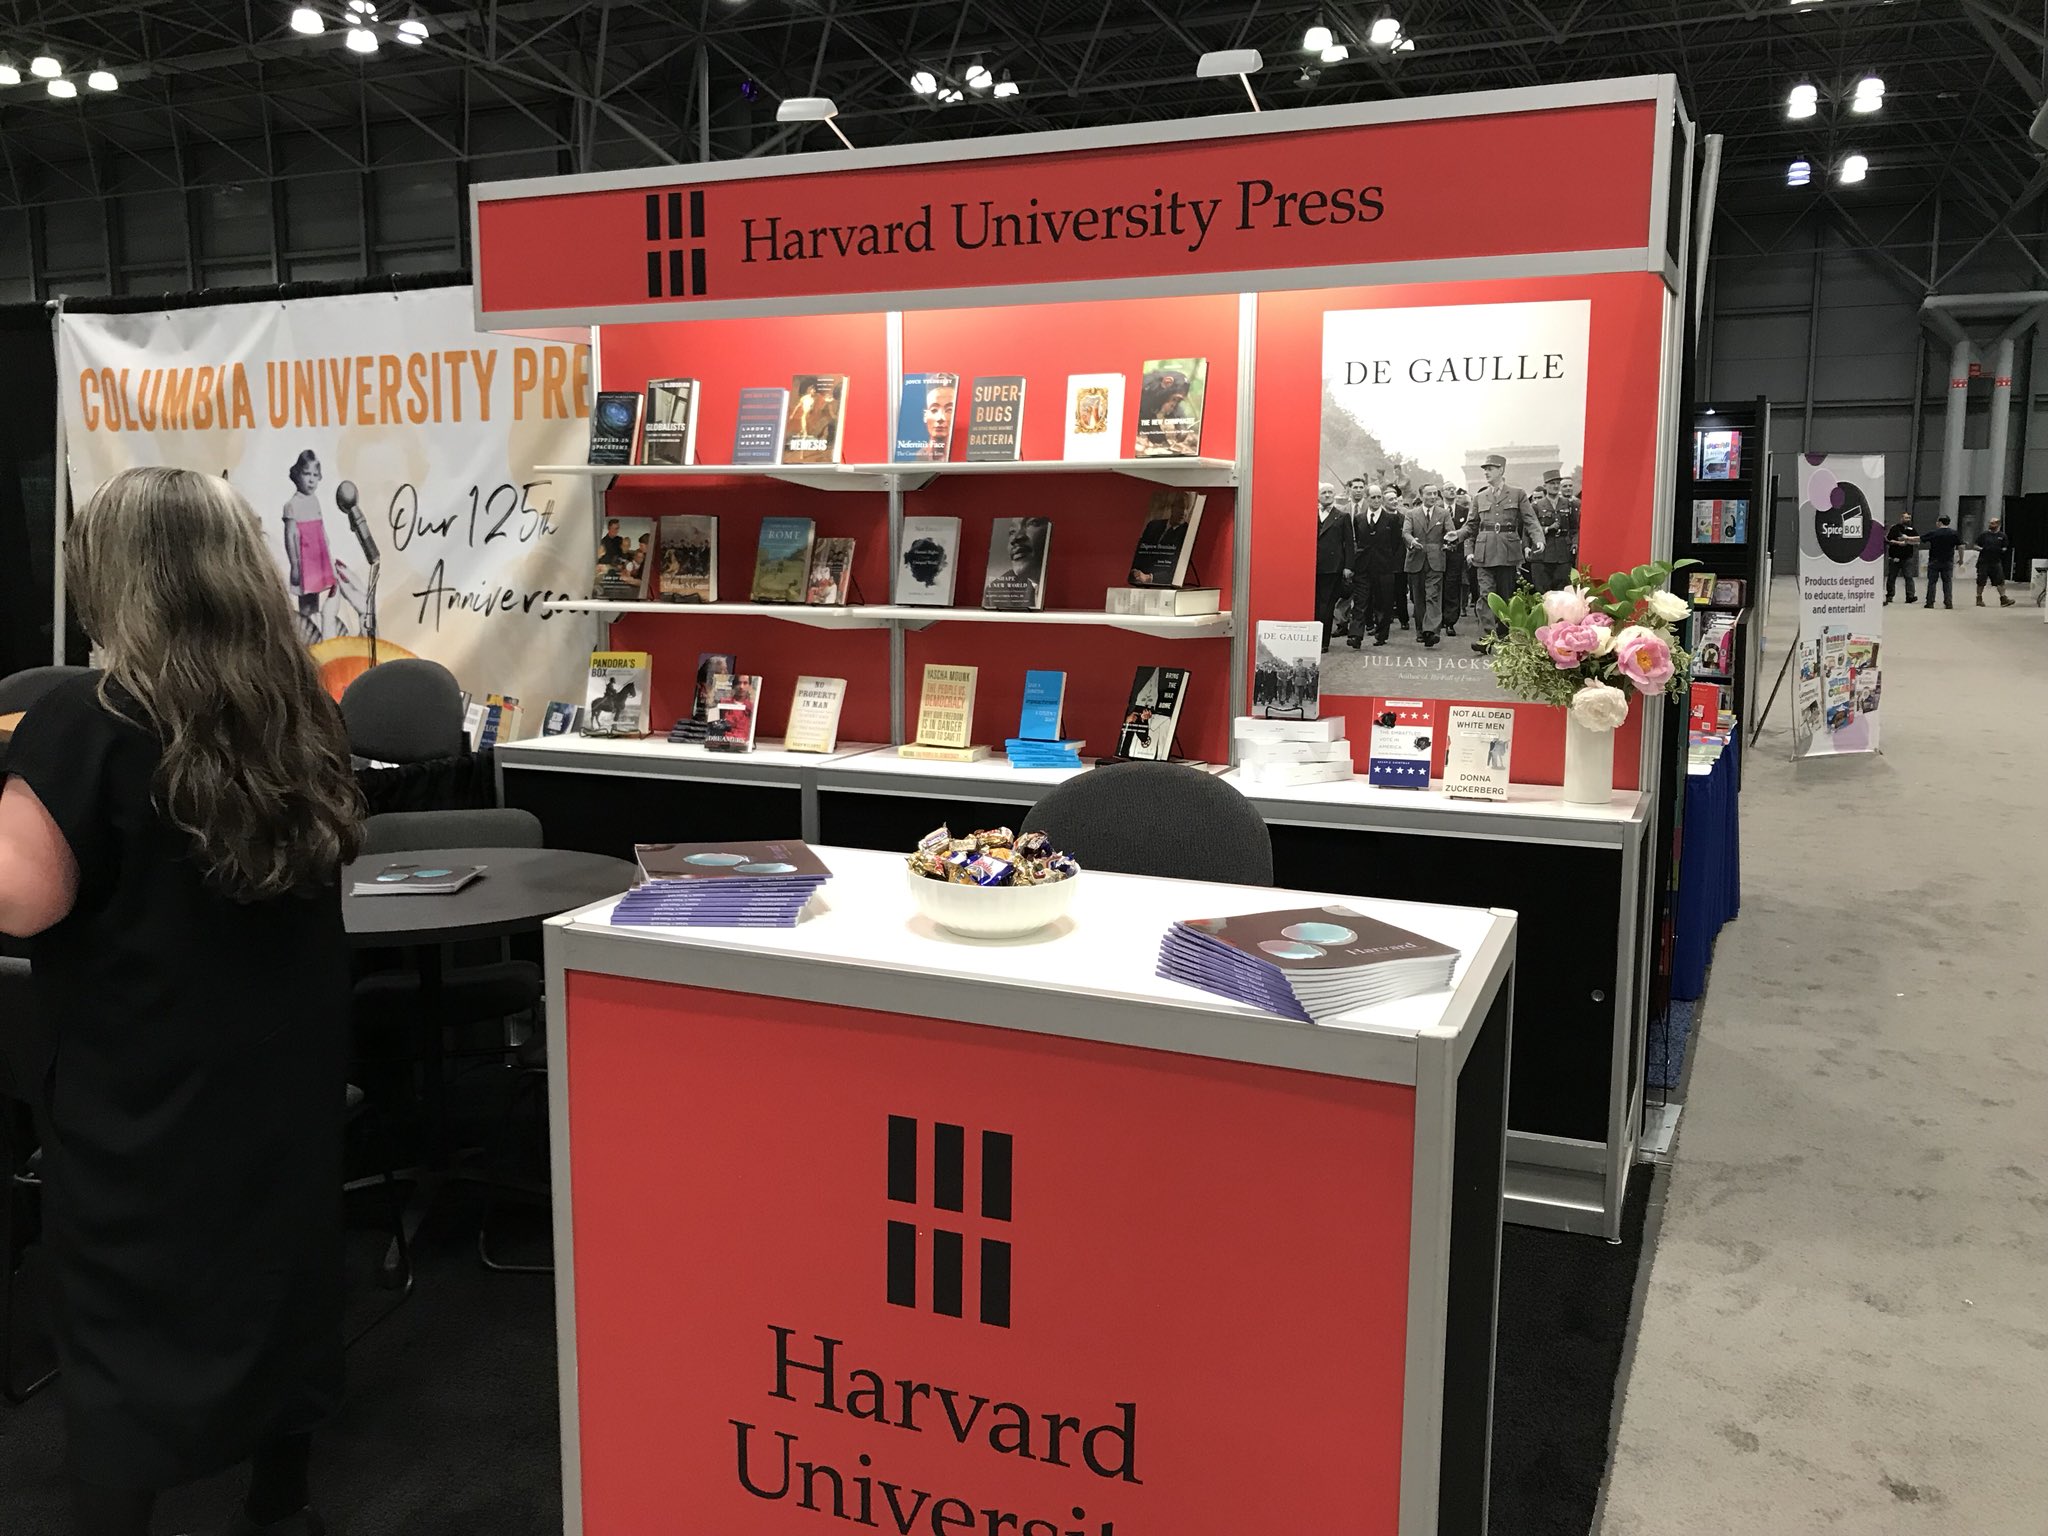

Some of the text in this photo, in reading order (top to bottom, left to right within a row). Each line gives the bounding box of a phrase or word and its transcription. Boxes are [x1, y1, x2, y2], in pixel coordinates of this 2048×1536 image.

[741, 179, 1386, 262] Harvard University Press
[1344, 353, 1565, 385] DE GAULLE
[80, 344, 589, 432] COLUMBIA UNIVERSITY PRE
[976, 406, 1013, 423] BUGS
[645, 422, 686, 432] GLOBALISTS
[790, 439, 828, 451] NEMESIS
[969, 434, 1014, 446] BACTERIA
[389, 483, 458, 551] Our
[768, 530, 800, 540] ROME
[1805, 576, 1875, 588] Products designed
[1804, 590, 1875, 602] to educate, inspire
[1812, 604, 1865, 614] and entertain!
[1279, 633, 1319, 642] GAULLE
[592, 659, 635, 669] PANDORA'S
[1363, 655, 1490, 671] JULIAN JACKS
[591, 668, 607, 677] BOX
[798, 690, 837, 699] PROPERTY
[937, 684, 957, 695] PEOPLE
[812, 701, 828, 709] MAN
[924, 694, 966, 709] DEMOCRACY
[1452, 710, 1469, 718] NOT
[1488, 711, 1511, 720] DEAD
[921, 719, 962, 732] IS IN DANGER
[1457, 721, 1505, 730] WHITE MEN
[1460, 774, 1491, 782] DONNA
[1445, 784, 1504, 795] ZUCKERBERG
[1345, 942, 1417, 955] Harvard
[767, 1324, 1143, 1485] Harvard
